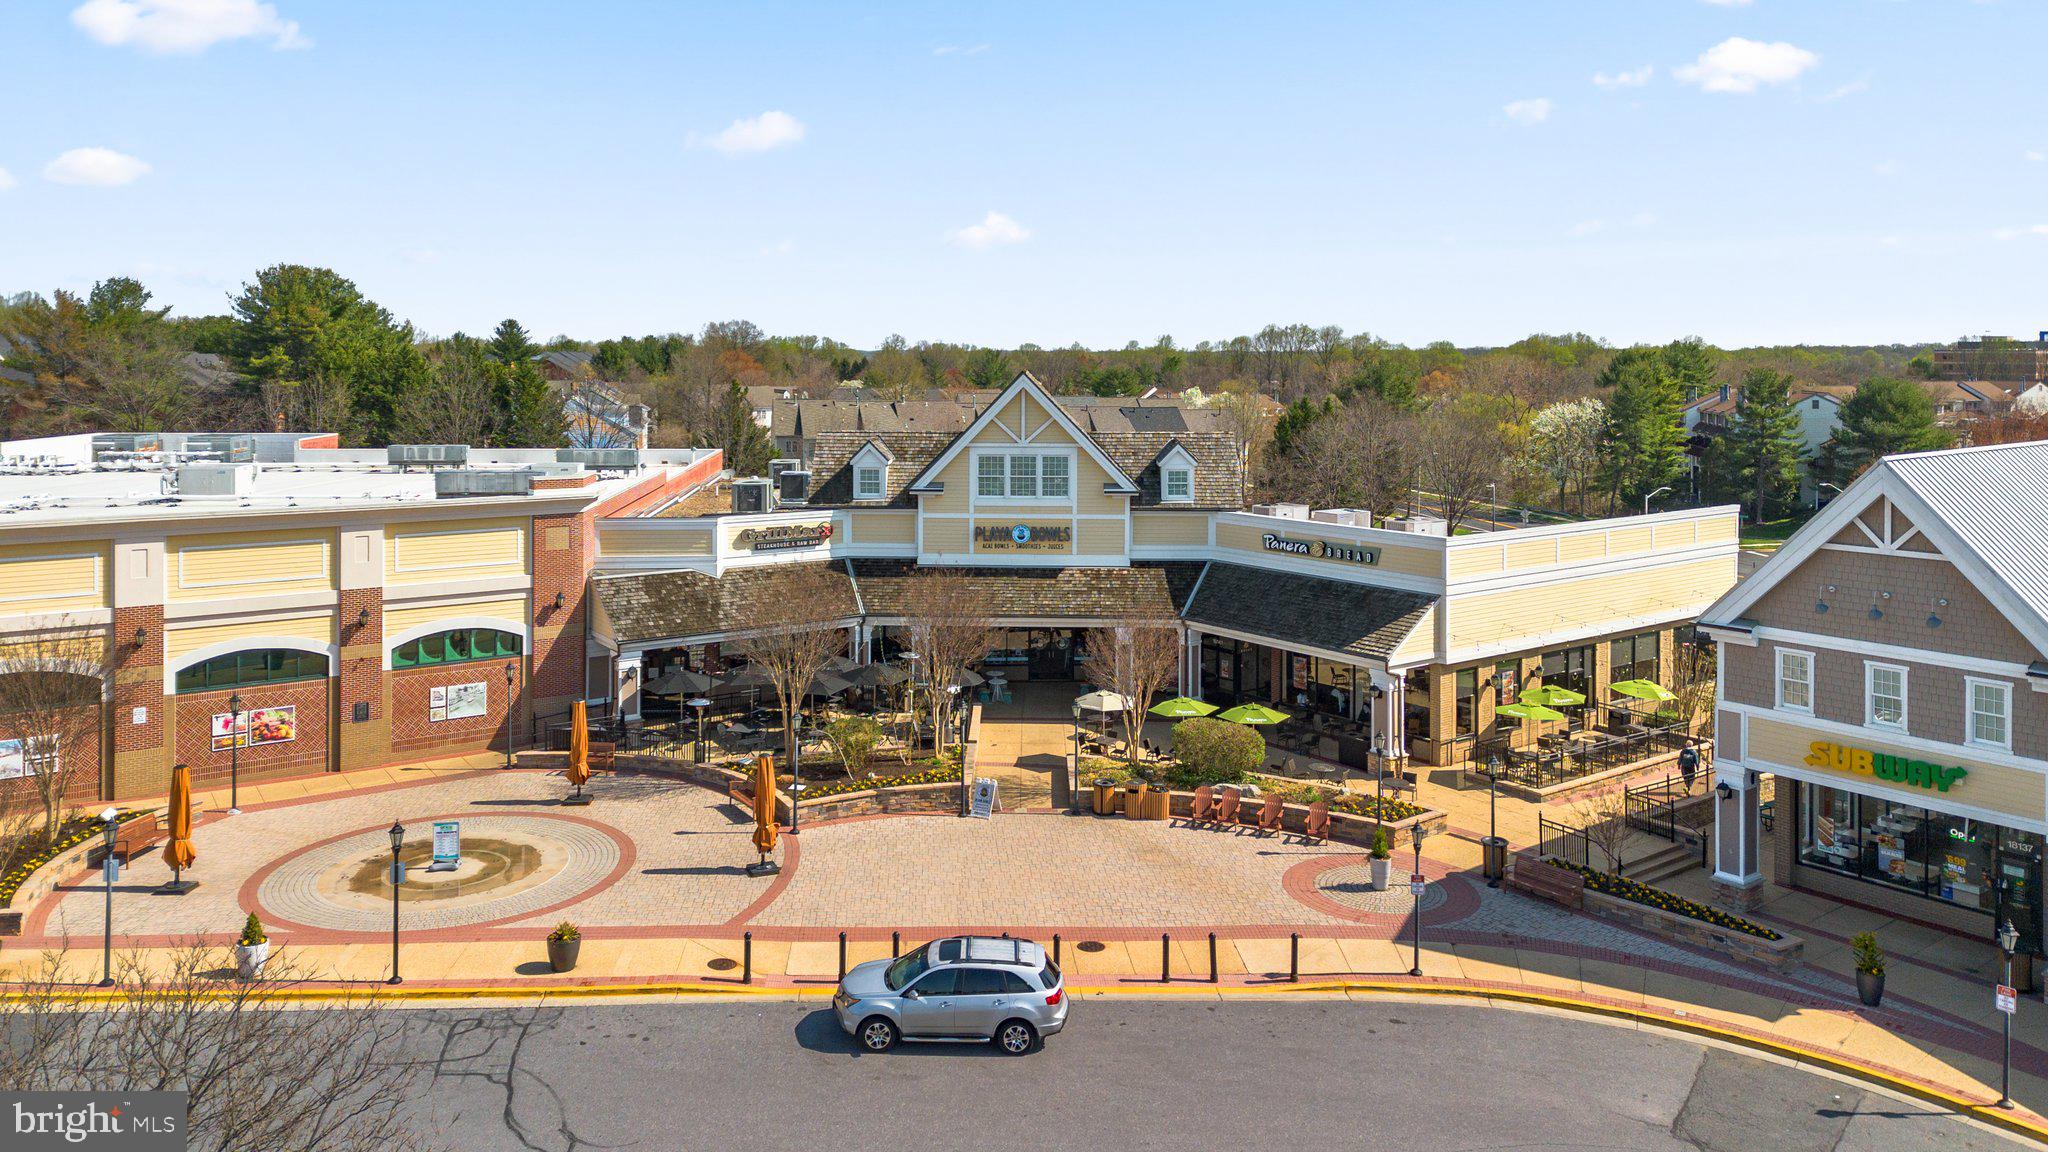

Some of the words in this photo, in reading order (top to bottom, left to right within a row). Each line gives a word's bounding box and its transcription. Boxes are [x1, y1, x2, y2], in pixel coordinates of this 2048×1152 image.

[975, 526, 1011, 542] PLAYA
[1031, 526, 1071, 542] BOWLS
[757, 541, 790, 550] STEAKHOUSE
[1262, 534, 1308, 554] Panera
[1326, 547, 1373, 563] BREAD
[1803, 741, 1968, 793] SUBWAY
[2007, 840, 2034, 853] 18137
